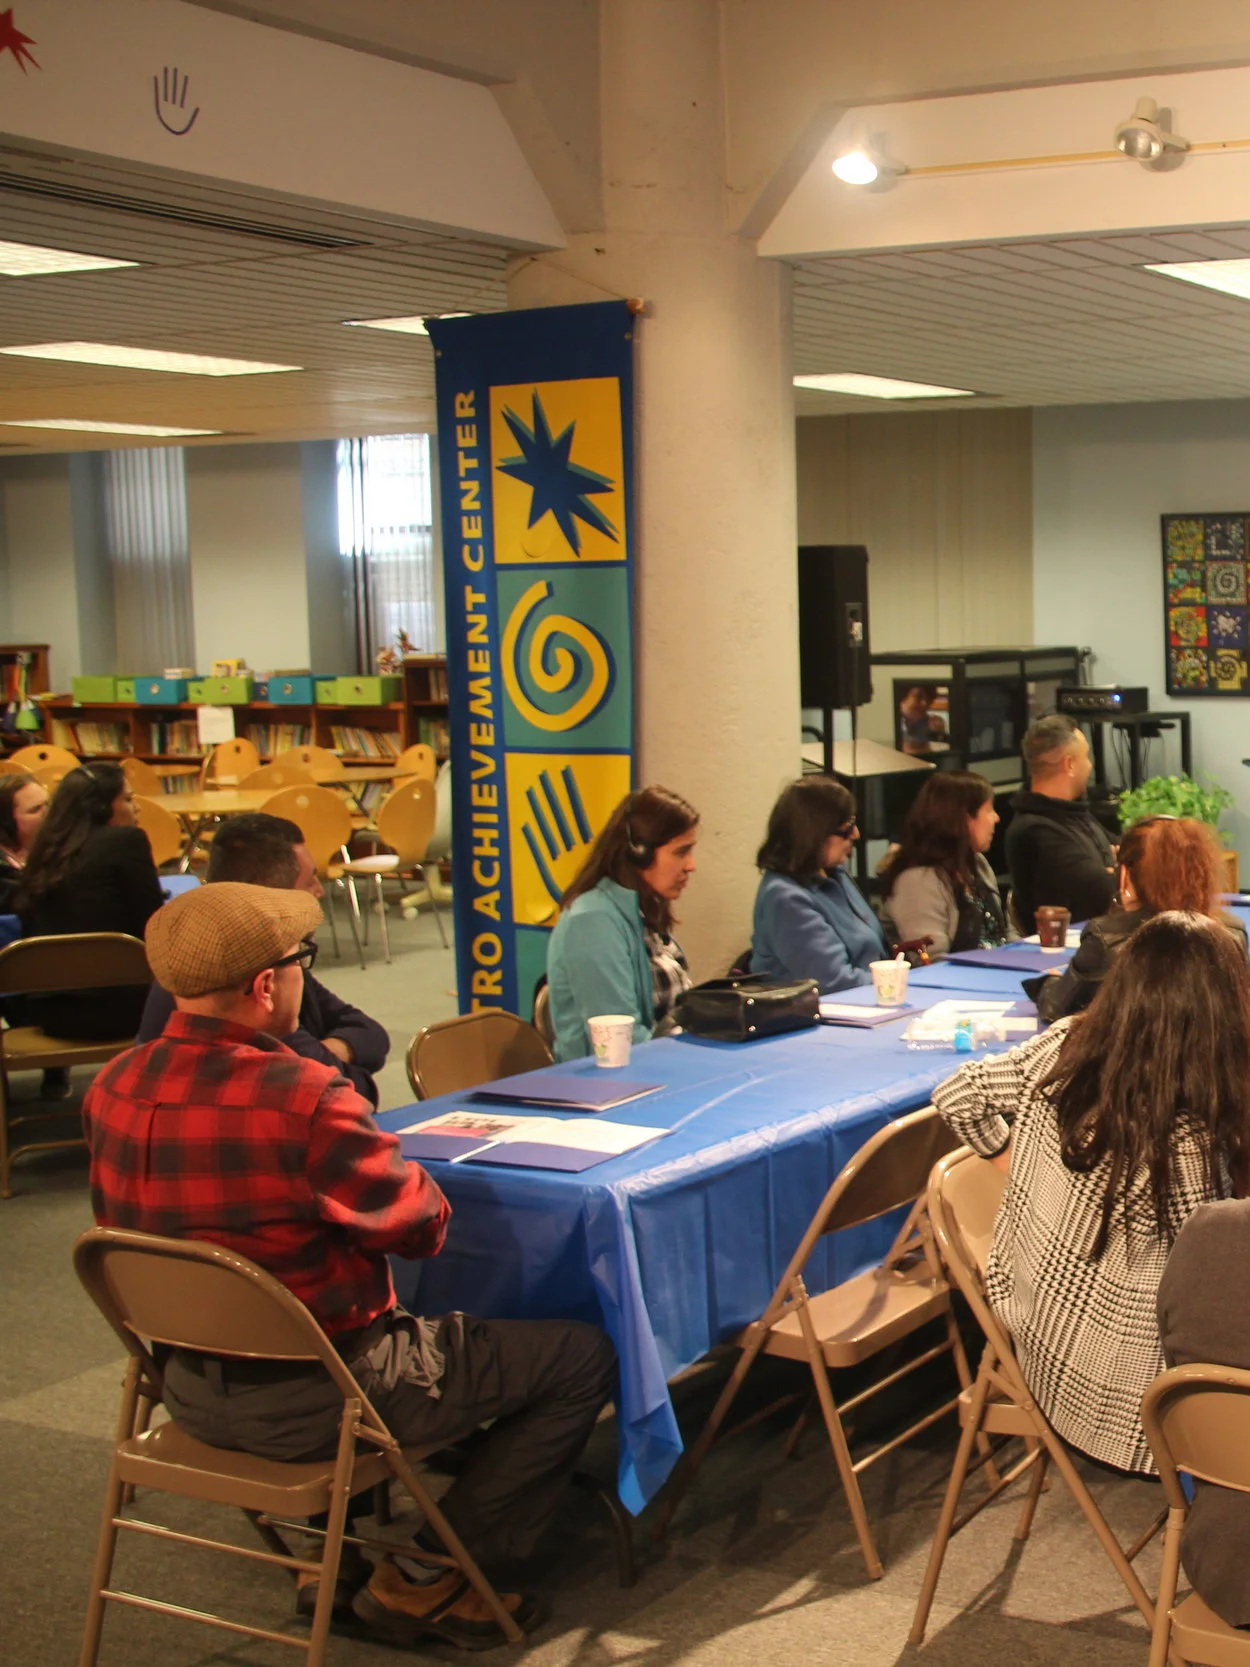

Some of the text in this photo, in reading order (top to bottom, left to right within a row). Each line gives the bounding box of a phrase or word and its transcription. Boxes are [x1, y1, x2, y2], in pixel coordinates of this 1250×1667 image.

[456, 391, 503, 1012] TRO ACHIEVEMENT CENTER
